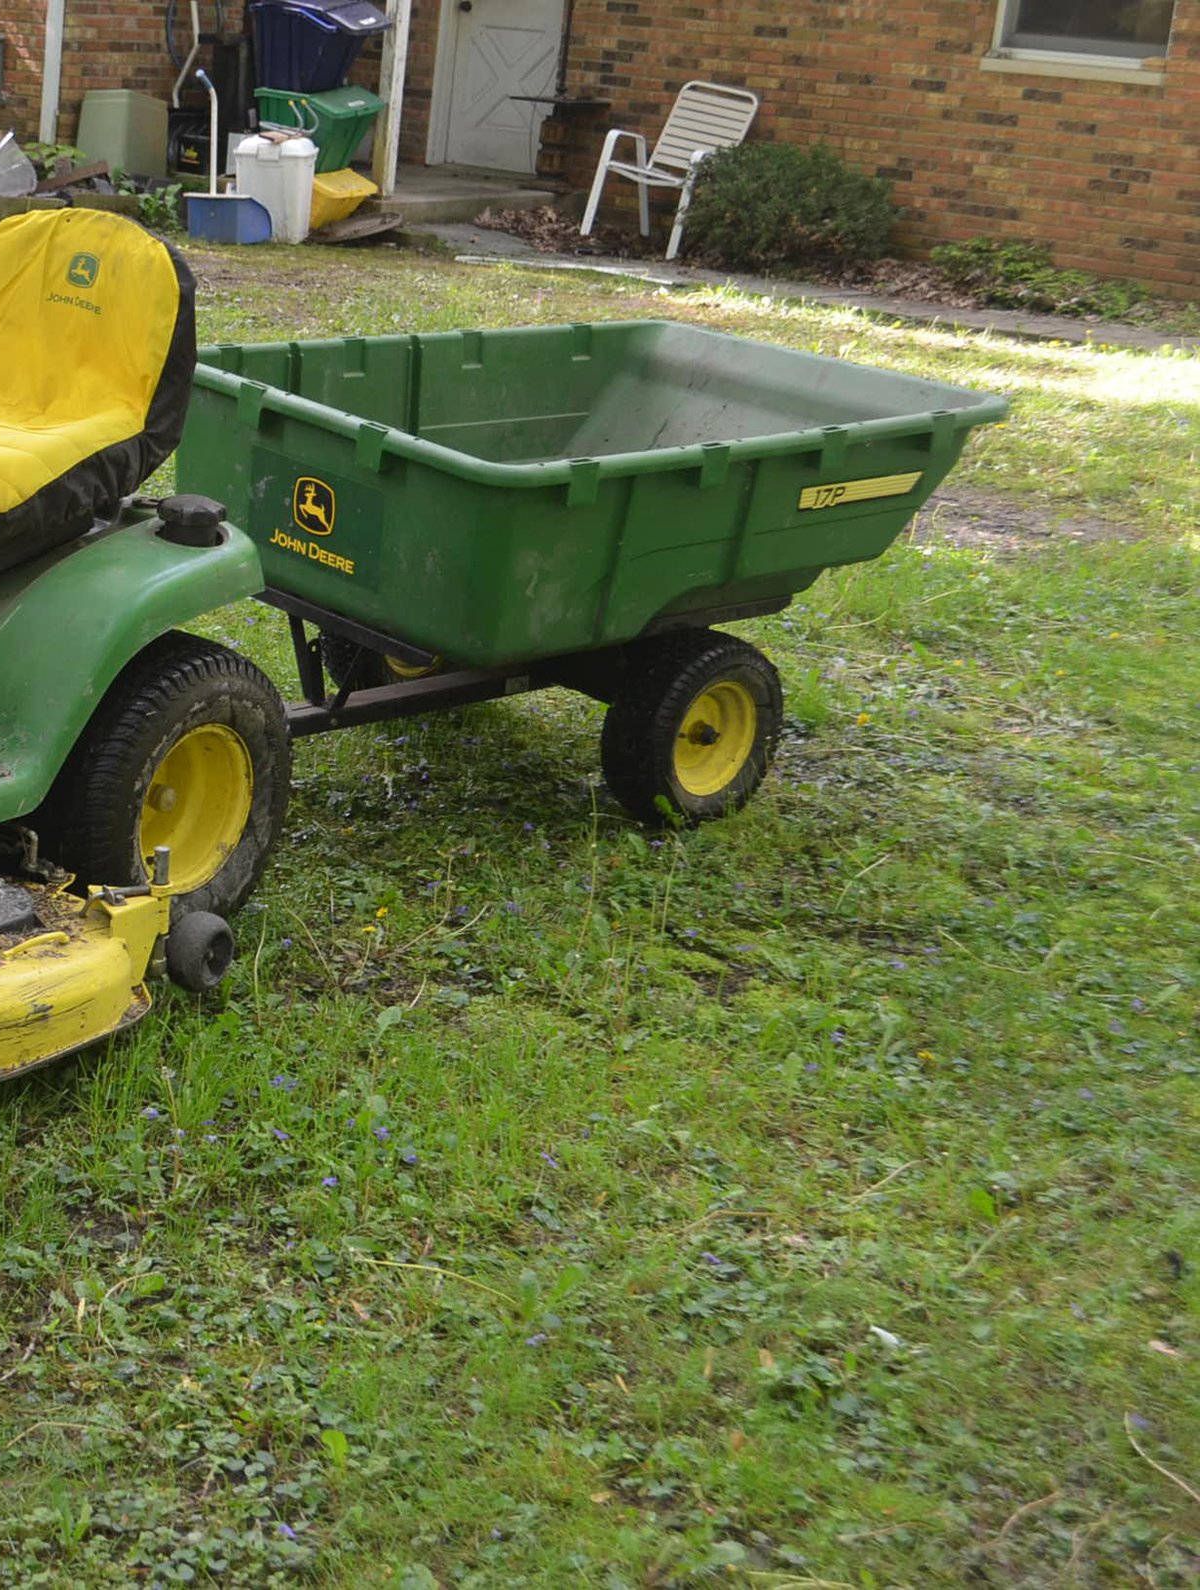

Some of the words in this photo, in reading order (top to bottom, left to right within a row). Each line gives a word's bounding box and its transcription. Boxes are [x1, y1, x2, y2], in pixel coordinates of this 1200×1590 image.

[46, 293, 74, 305] JOHN
[813, 486, 846, 507] 17P
[269, 527, 307, 556] JOHN
[308, 542, 355, 575] DEERE
